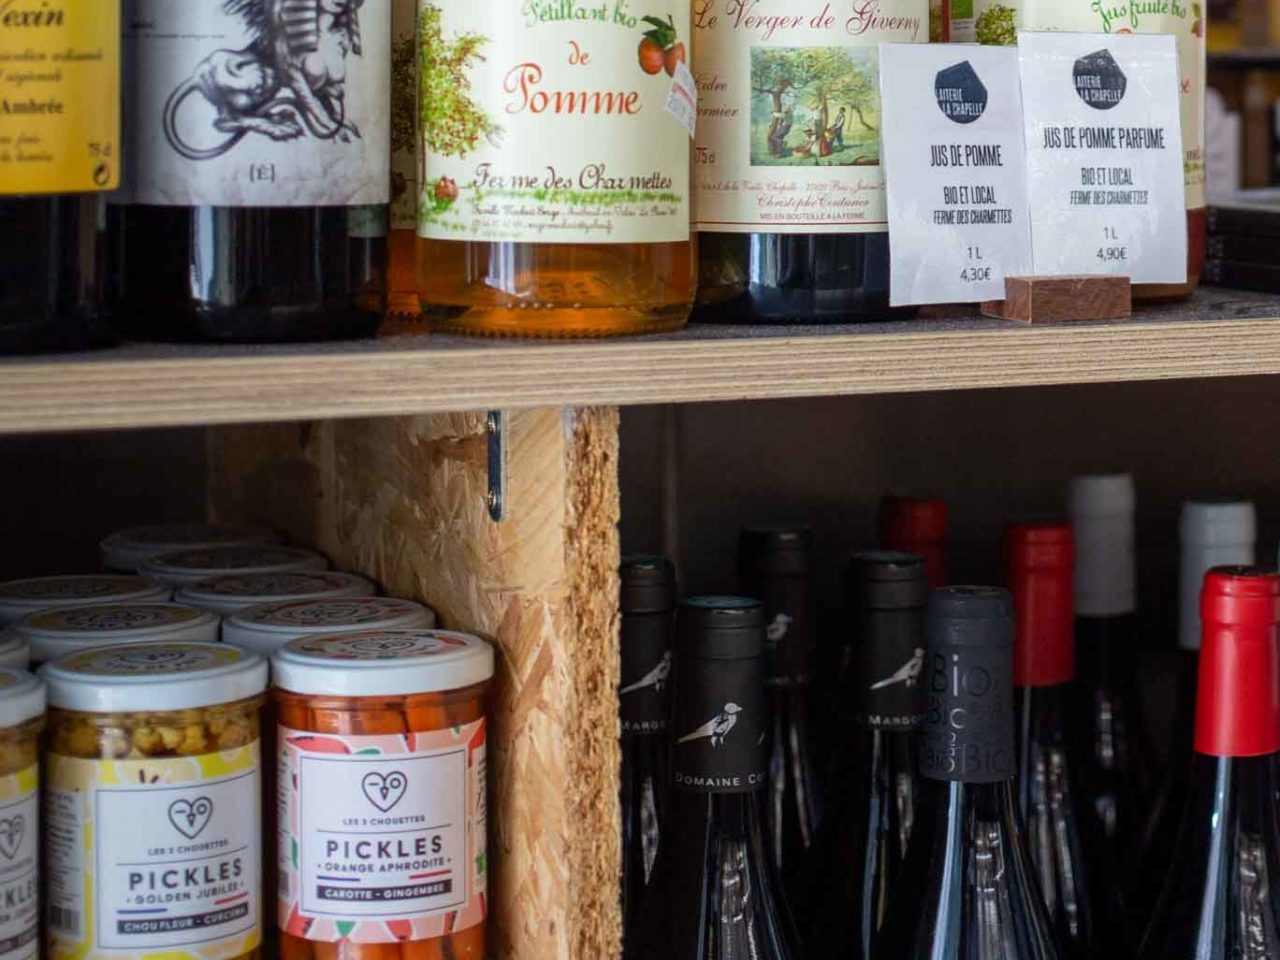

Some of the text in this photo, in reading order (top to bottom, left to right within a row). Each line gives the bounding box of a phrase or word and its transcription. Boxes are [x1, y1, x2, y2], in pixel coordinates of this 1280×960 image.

[809, 3, 836, 29] de
[568, 40, 591, 65] de
[502, 62, 643, 114] Pomme
[695, 99, 740, 117] ermier
[952, 102, 984, 116] CHAPELLE
[1043, 127, 1166, 149] JUS DE POMME PARFUME
[930, 144, 1004, 167] JUS DE POMME
[472, 162, 538, 189] Ferme
[543, 166, 573, 190] des
[578, 163, 673, 190] Charmettes
[1081, 167, 1134, 186] BIO ET LOCAL
[943, 185, 997, 205] BIO ET LOCAL
[1070, 190, 1149, 205] FERME DES CHARMETTES
[933, 209, 1013, 225] FERME DES CHARMETTES
[1103, 226, 1119, 240] 1 L
[967, 246, 983, 259] 1 L
[1096, 247, 1128, 262] 4,90€
[960, 267, 992, 283] 4,30€
[675, 772, 741, 787] DOMAINE
[326, 835, 442, 859] PICKLES
[324, 858, 445, 873] ORANGE APHRODITE
[128, 858, 243, 891] PICKLES
[134, 893, 192, 905] GOLDEN
[324, 889, 374, 900] CAROTTE
[383, 883, 445, 900] GINGEMBRE
